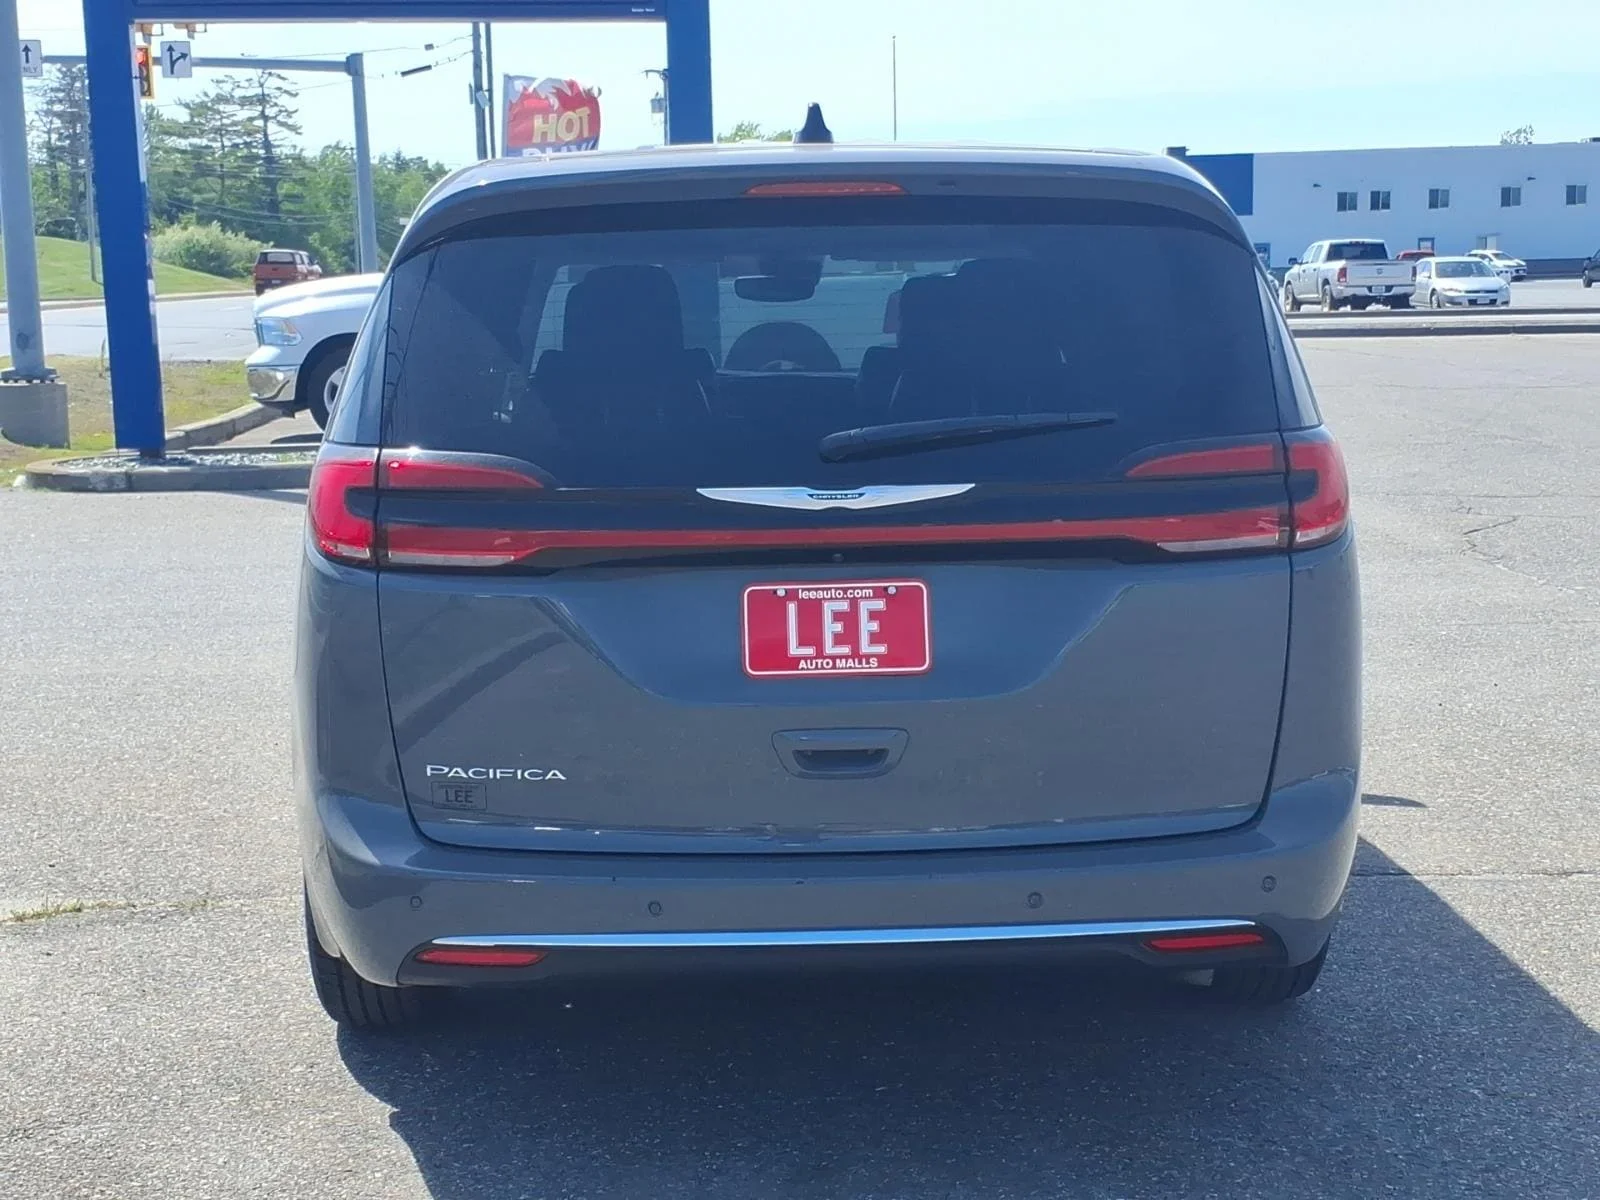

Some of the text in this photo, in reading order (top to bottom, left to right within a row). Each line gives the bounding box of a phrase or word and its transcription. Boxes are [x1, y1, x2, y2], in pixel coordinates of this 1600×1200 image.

[532, 106, 590, 143] HOT
[798, 588, 873, 599] leeauto.com
[787, 599, 887, 657] LEE
[798, 657, 878, 669] AUTO MALLS
[426, 764, 567, 780] PACIFICA
[445, 789, 473, 803] LEE
